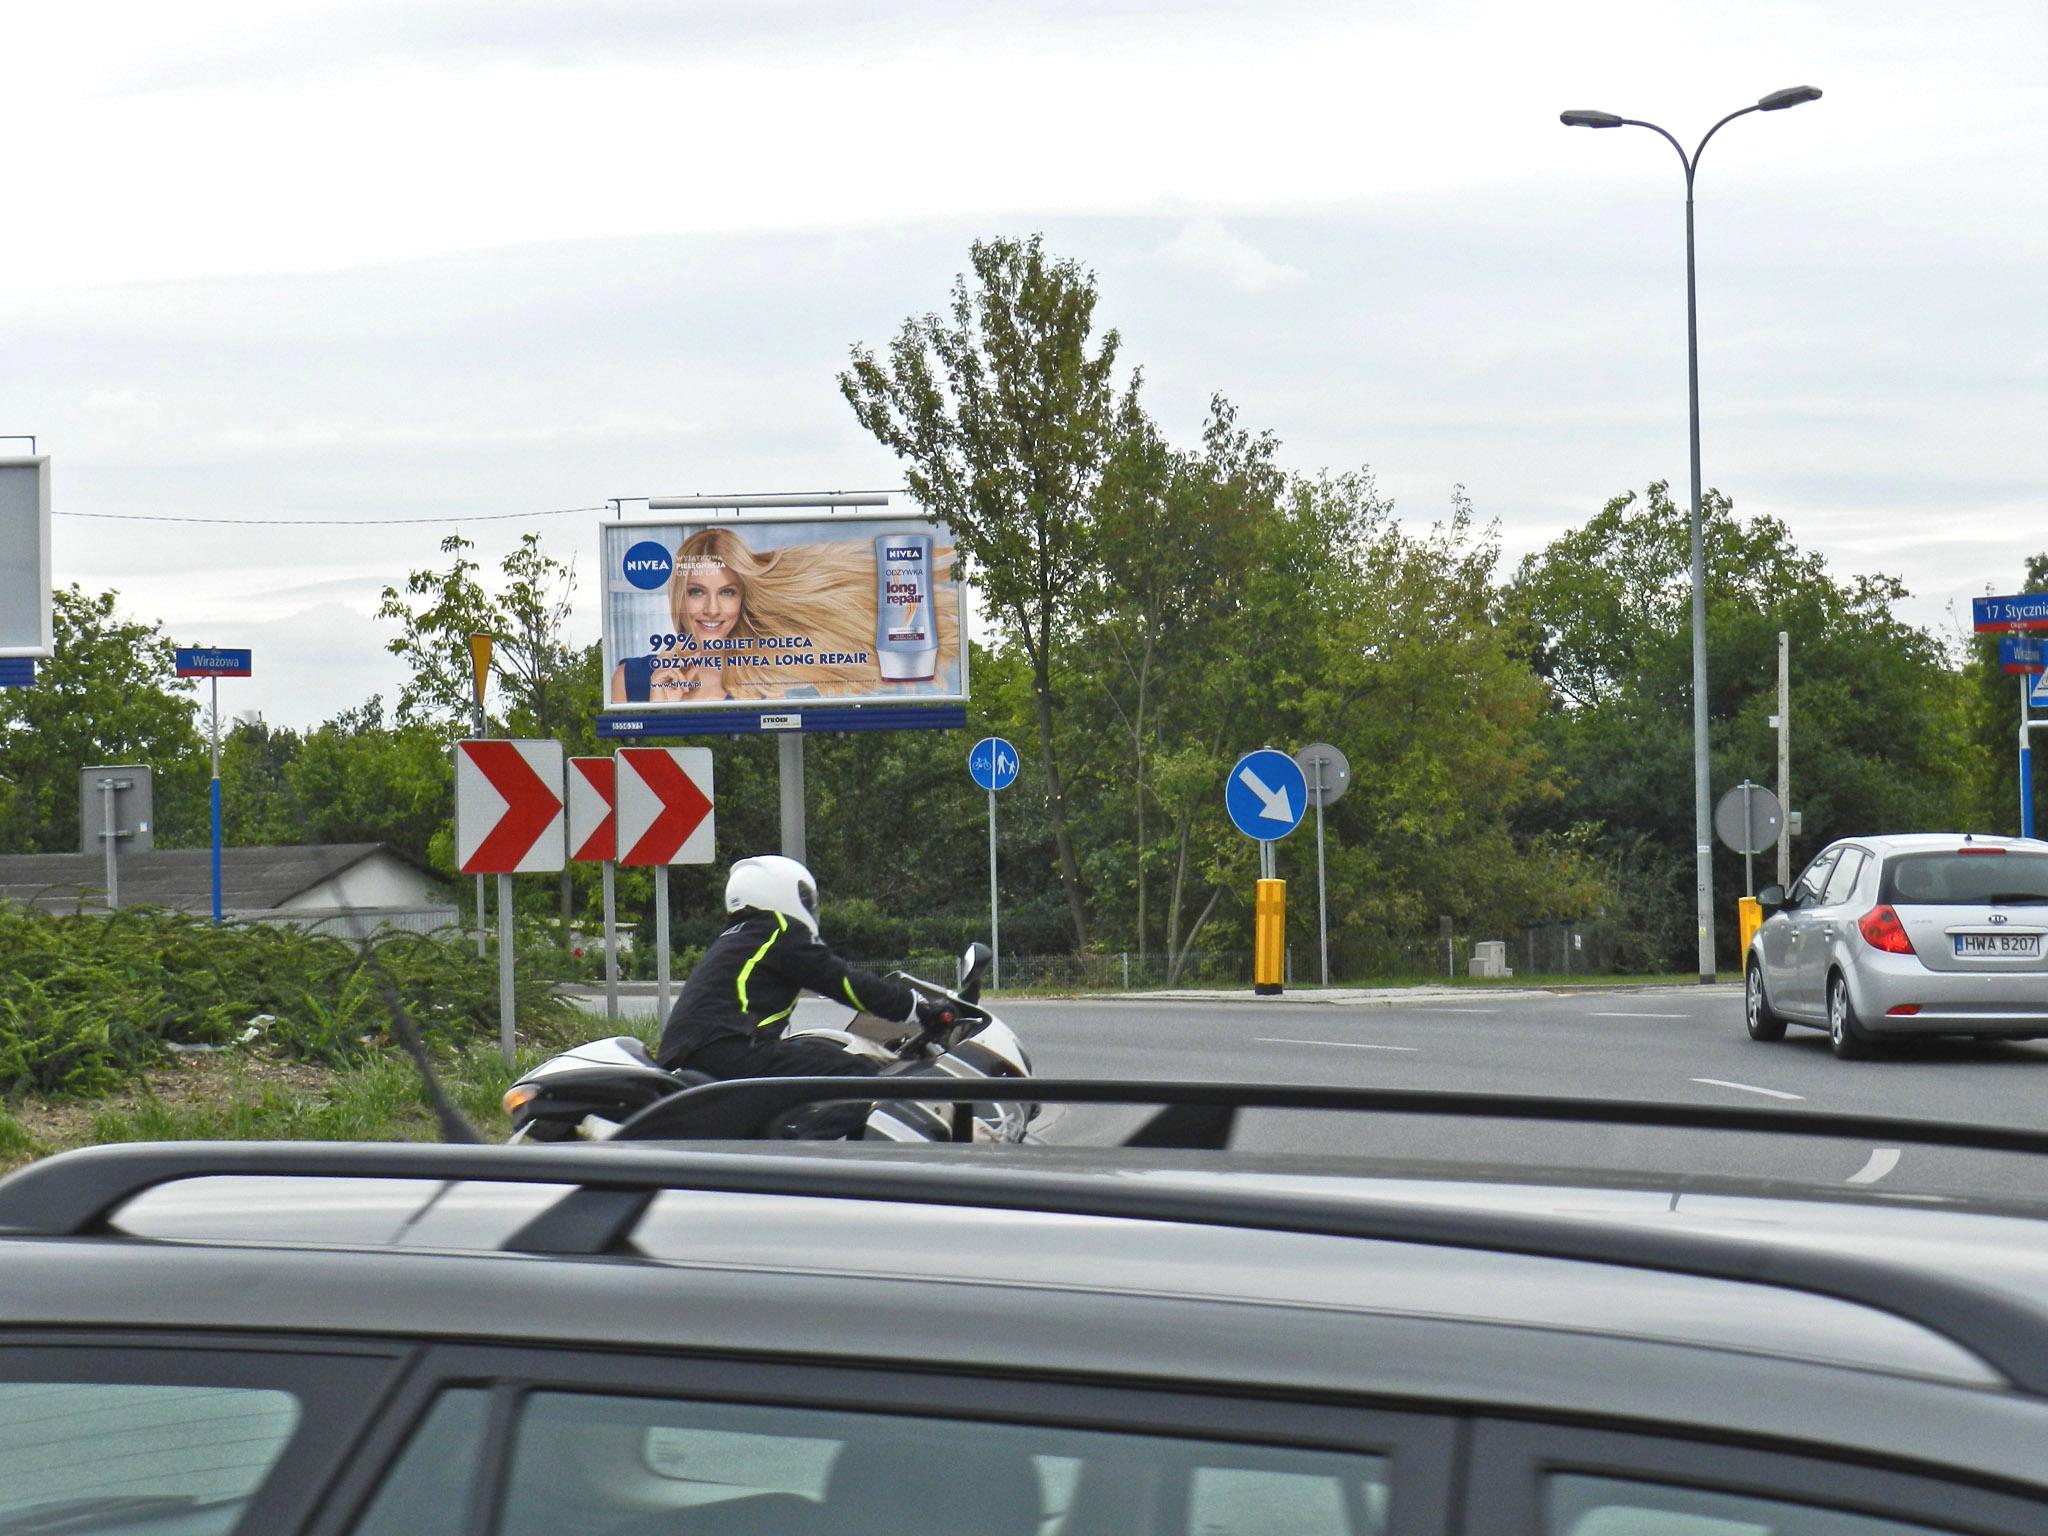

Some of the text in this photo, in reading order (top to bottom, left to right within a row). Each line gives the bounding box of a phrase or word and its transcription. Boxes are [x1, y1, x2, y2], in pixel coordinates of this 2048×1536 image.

[889, 549, 919, 558] NIVEA
[627, 560, 670, 570] NIVEA
[886, 581, 916, 595] long
[886, 593, 924, 606] repair
[1986, 605, 1999, 619] 17
[649, 633, 813, 652] 99% KOBIET POLECA
[192, 655, 239, 667] Wirażowa
[650, 654, 722, 670] ODŻYWKĘ
[727, 655, 770, 666] NIVEA
[775, 653, 815, 665] LONG
[1965, 937, 1997, 951] HWA
[2001, 937, 2036, 951] B207
